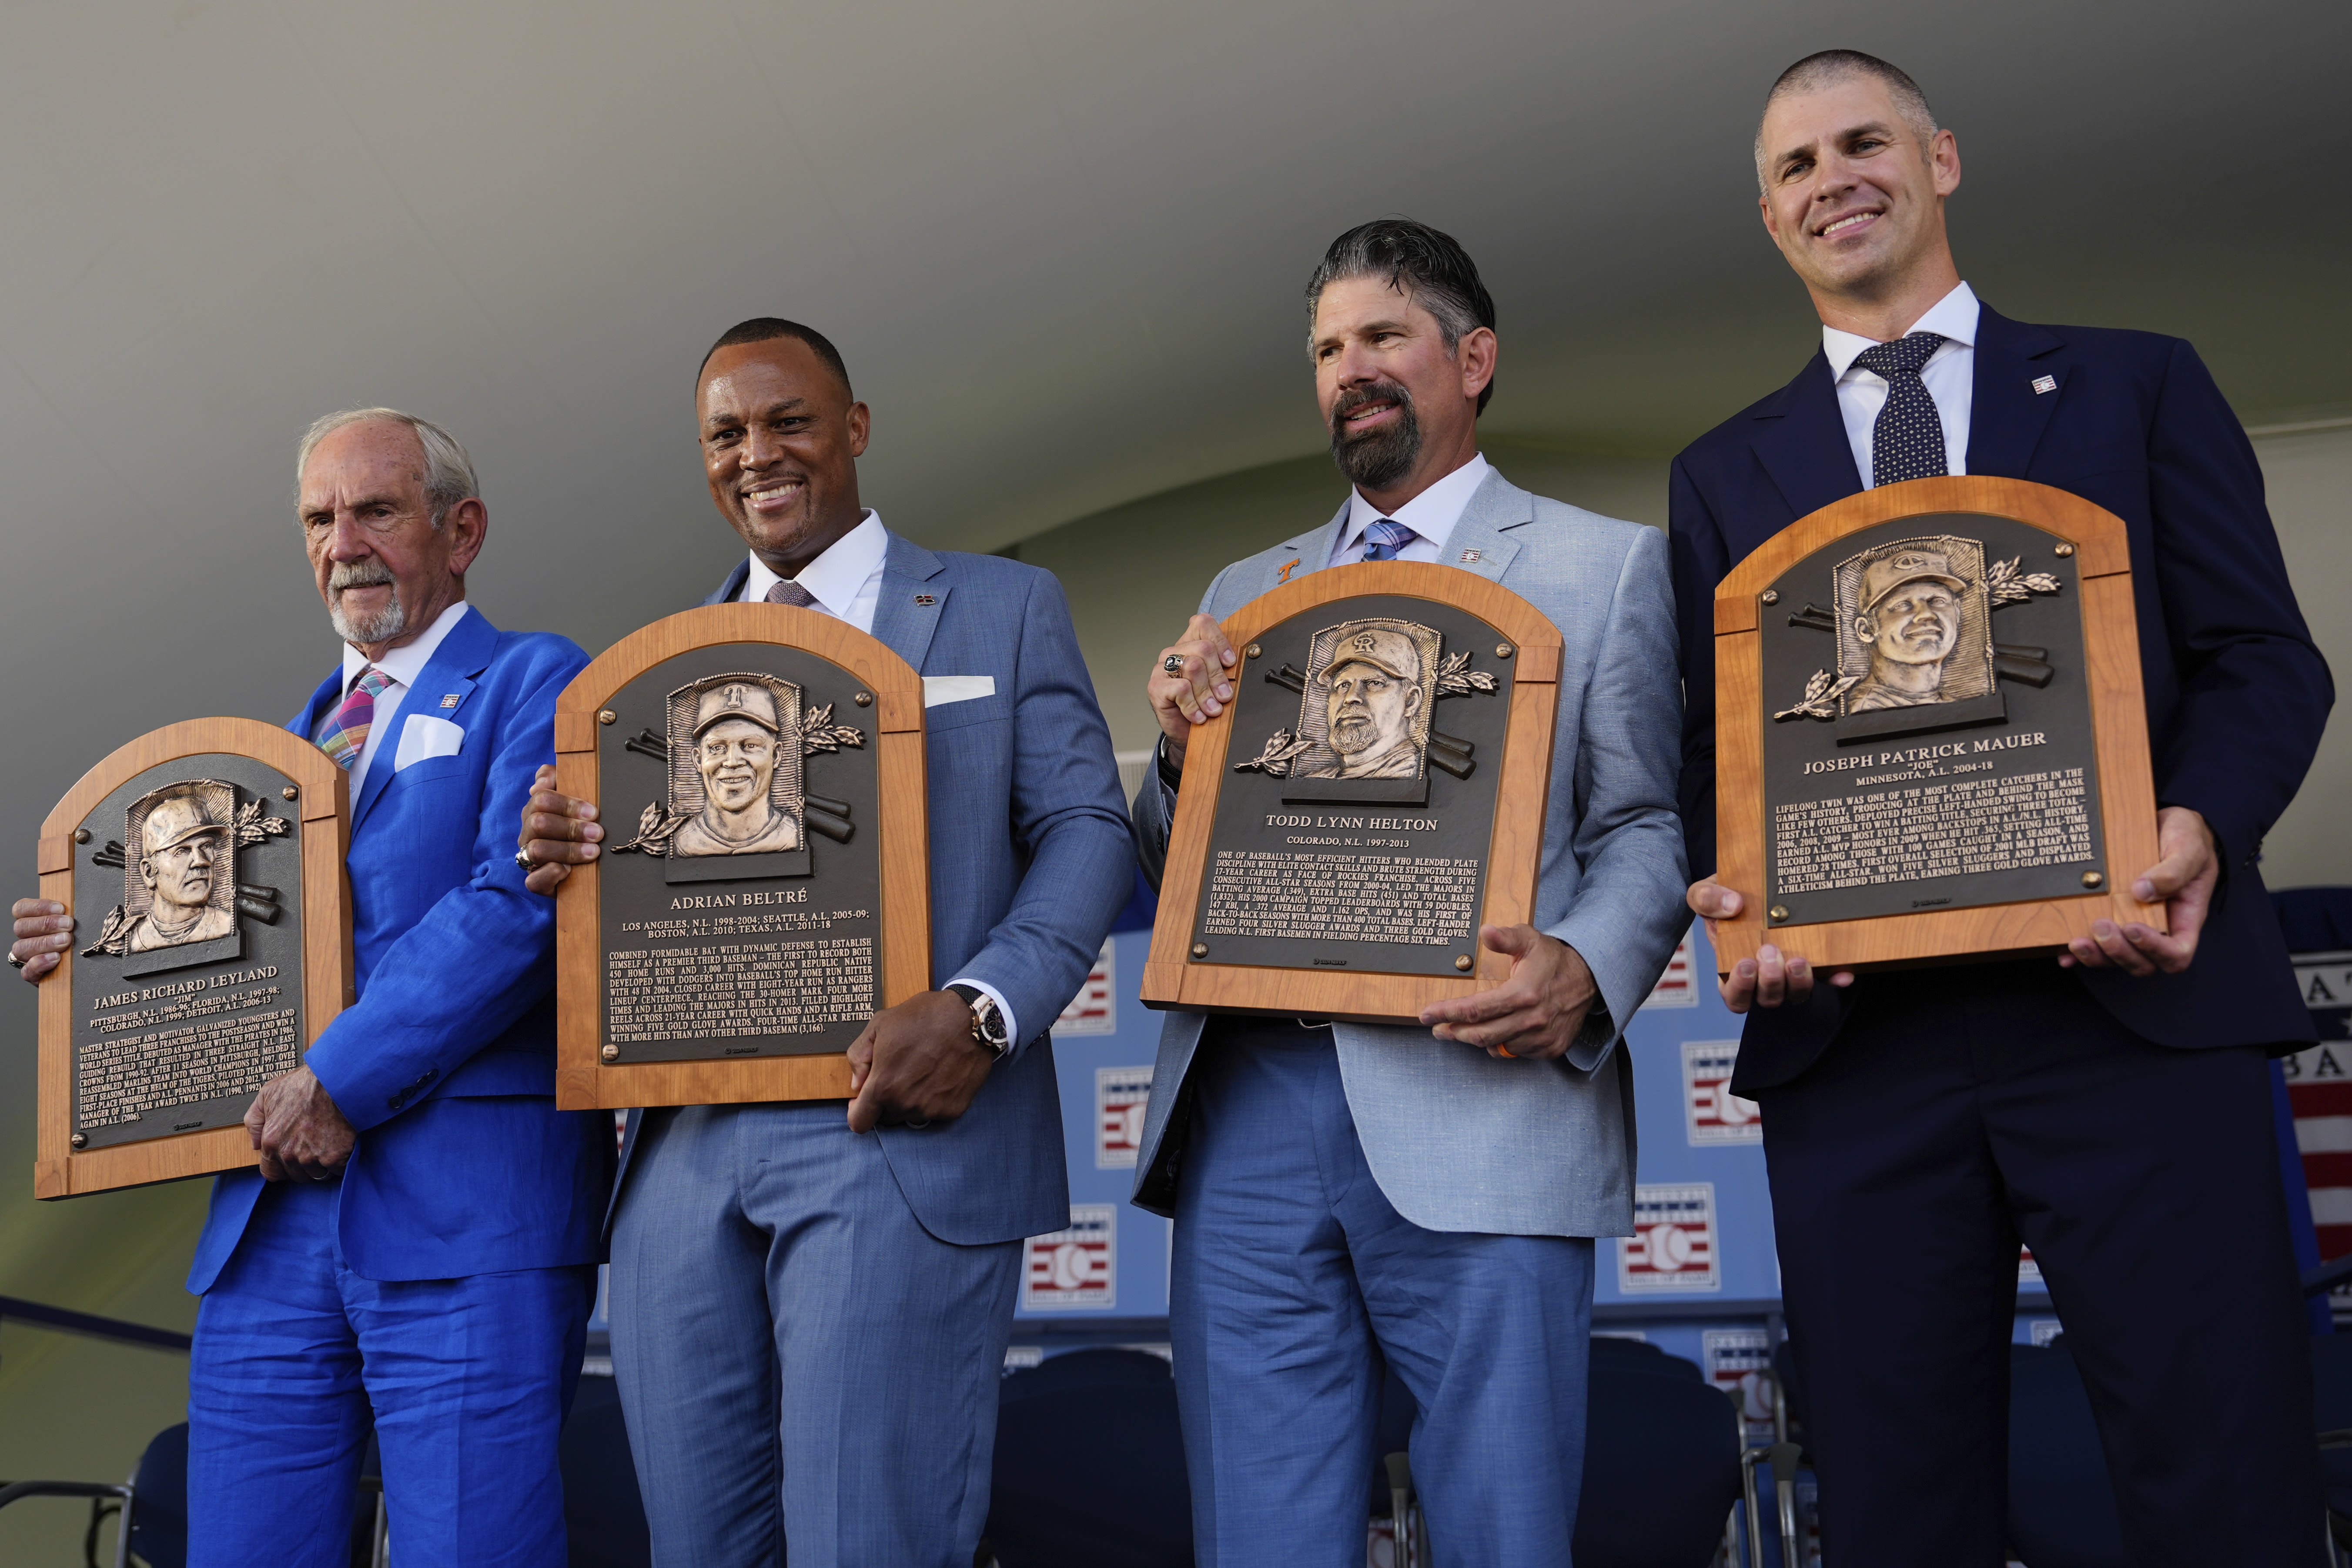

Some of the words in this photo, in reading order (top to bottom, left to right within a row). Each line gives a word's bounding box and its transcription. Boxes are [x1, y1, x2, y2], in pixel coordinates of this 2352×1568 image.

[724, 684, 748, 708] T
[1803, 754, 1873, 775] JOSEPH
[1880, 742, 1967, 765] PATRICK
[1973, 732, 2046, 752] MAUER
[1856, 770, 1925, 786] MINNESOTA,
[1928, 767, 1950, 777] A.L.
[1953, 761, 1993, 774] 2004-18
[1776, 801, 1817, 814] LIFELONG
[1820, 798, 1842, 809] TWIN
[1846, 795, 1864, 805] WAS
[1867, 792, 1885, 803] ONE
[1888, 791, 1900, 800] OF
[1903, 788, 1921, 798] THE
[1924, 785, 1948, 796] MOST
[1951, 779, 1997, 792] COMPLETE
[2001, 772, 2048, 786] CATCHERS
[2051, 771, 2061, 780] IN
[2064, 768, 2083, 778] THE
[1810, 806, 1849, 819] HISTORY,
[1853, 799, 1903, 813] PRODUCING
[1907, 798, 1918, 807] AT
[1921, 795, 1940, 805] THE
[1943, 791, 1971, 802] PLATE
[1975, 788, 1995, 798] AND
[1998, 783, 2033, 796] BEHIND
[2036, 780, 2054, 791] THE
[2058, 777, 2084, 788] MASK
[1266, 815, 1311, 826] TODD
[1316, 816, 1364, 829] LYNN
[1368, 818, 1438, 831] HELTON
[1287, 836, 1342, 846] COLORADO,
[1344, 838, 1362, 846] N.L.
[1366, 839, 1409, 848] 1997-2013
[1294, 853, 1315, 862] MOST
[1317, 854, 1356, 863] EFFICIENT
[1358, 856, 1391, 865] HITTERS
[1394, 857, 1411, 866] WHO
[1415, 857, 1450, 867] BLENDED
[1453, 859, 1478, 867] PLATE
[1215, 867, 1244, 876] 17-YEAR
[1249, 868, 1278, 877] CAREER
[1297, 870, 1317, 879] FACE
[1322, 871, 1332, 879] OF
[1337, 872, 1369, 881] ROCKIES
[1374, 873, 1418, 883] FRANCHISE.
[1424, 875, 1452, 884] ACROSS
[1458, 876, 1476, 885] FIVE
[670, 894, 736, 909] ADRIAN
[742, 887, 807, 905] BELTRÉ
[622, 922, 640, 931] LOS
[643, 919, 690, 932] ANGELES,
[693, 919, 711, 927] N.L.
[714, 916, 760, 928] 1998-2004;
[763, 913, 808, 926] SEATTLE,
[811, 912, 830, 921] A.L.
[832, 909, 869, 919] 2005-09;
[648, 927, 689, 938] BOSTON,
[692, 927, 710, 936] A.L.
[713, 926, 736, 935] 2010;
[738, 923, 773, 933] TEXAS,
[776, 923, 794, 931] A.L.
[797, 920, 831, 930] 2011-18
[609, 950, 647, 960] COMBINED
[651, 947, 698, 958] FORMIDABLE
[702, 946, 716, 955] BAT
[720, 945, 739, 954] WITH
[743, 943, 778, 953] DYNAMIC
[781, 941, 815, 951] DEFENSE
[818, 940, 828, 949] TO
[832, 938, 872, 948] ESTABLISH
[609, 970, 621, 978] 450
[627, 968, 649, 977] HOME
[655, 967, 675, 976] RUNS
[681, 966, 697, 975] AND
[703, 964, 721, 975] 3,000
[727, 963, 746, 972] HITS.
[753, 960, 795, 971] DOMINICAN
[801, 958, 838, 968] REPUBLIC
[844, 956, 872, 966] NATIVE
[94, 991, 138, 1010] JAMES
[142, 979, 205, 1000] RICHARD
[210, 966, 277, 988] LEYLAND
[610, 996, 637, 1006] LINEUP
[641, 993, 693, 1004] CENTERPIECE,
[698, 991, 736, 1001] REACHING
[740, 990, 755, 999] THE
[759, 988, 796, 998] 30-HOMER
[801, 986, 823, 996] MARK
[827, 985, 847, 994] FOUR
[852, 983, 873, 993] MORE
[90, 1011, 141, 1027] PITTSBURGH,
[142, 1008, 158, 1018] N.L.
[160, 1002, 190, 1015] 1986-96;
[192, 995, 229, 1011] FLORIDA,
[231, 992, 247, 1002] N.L.
[249, 986, 279, 1000] 1997-98;
[100, 1019, 146, 1033] COLORADO,
[147, 1016, 164, 1025] N.L.
[166, 1012, 184, 1021] 1999;
[186, 1004, 223, 1018] DETROIT,
[225, 1001, 241, 1011] A.L.
[242, 995, 271, 1008] 2006-13
[79, 1043, 103, 1054] MASTER
[104, 1036, 142, 1050] STRATEGIST
[143, 1033, 157, 1043] AND
[158, 1026, 194, 1040] MOTIVATOR
[196, 1019, 236, 1033] GALVANIZED
[238, 1011, 279, 1026] YOUNGSTERS
[281, 1008, 294, 1018] AND
[79, 1067, 106, 1079] GUIDING
[109, 1062, 136, 1074] REBUILD
[139, 1058, 156, 1069] THAT
[159, 1053, 191, 1065] RESULTED
[194, 1050, 201, 1059] IN
[204, 1046, 225, 1057] THREE
[228, 1040, 260, 1053] STRAIGHT
[263, 1038, 276, 1046] N.L.
[279, 1033, 295, 1044] EAST
[79, 1081, 122, 1096] REASSEMBLED
[124, 1076, 151, 1088] MARLINS
[153, 1073, 170, 1083] TEAM
[172, 1070, 187, 1080] INTO
[189, 1066, 212, 1076] WORLD
[214, 1059, 250, 1072] CHAMPIONS
[251, 1057, 259, 1066] IN
[261, 1054, 277, 1064] 1997.
[278, 1051, 296, 1061] OVER
